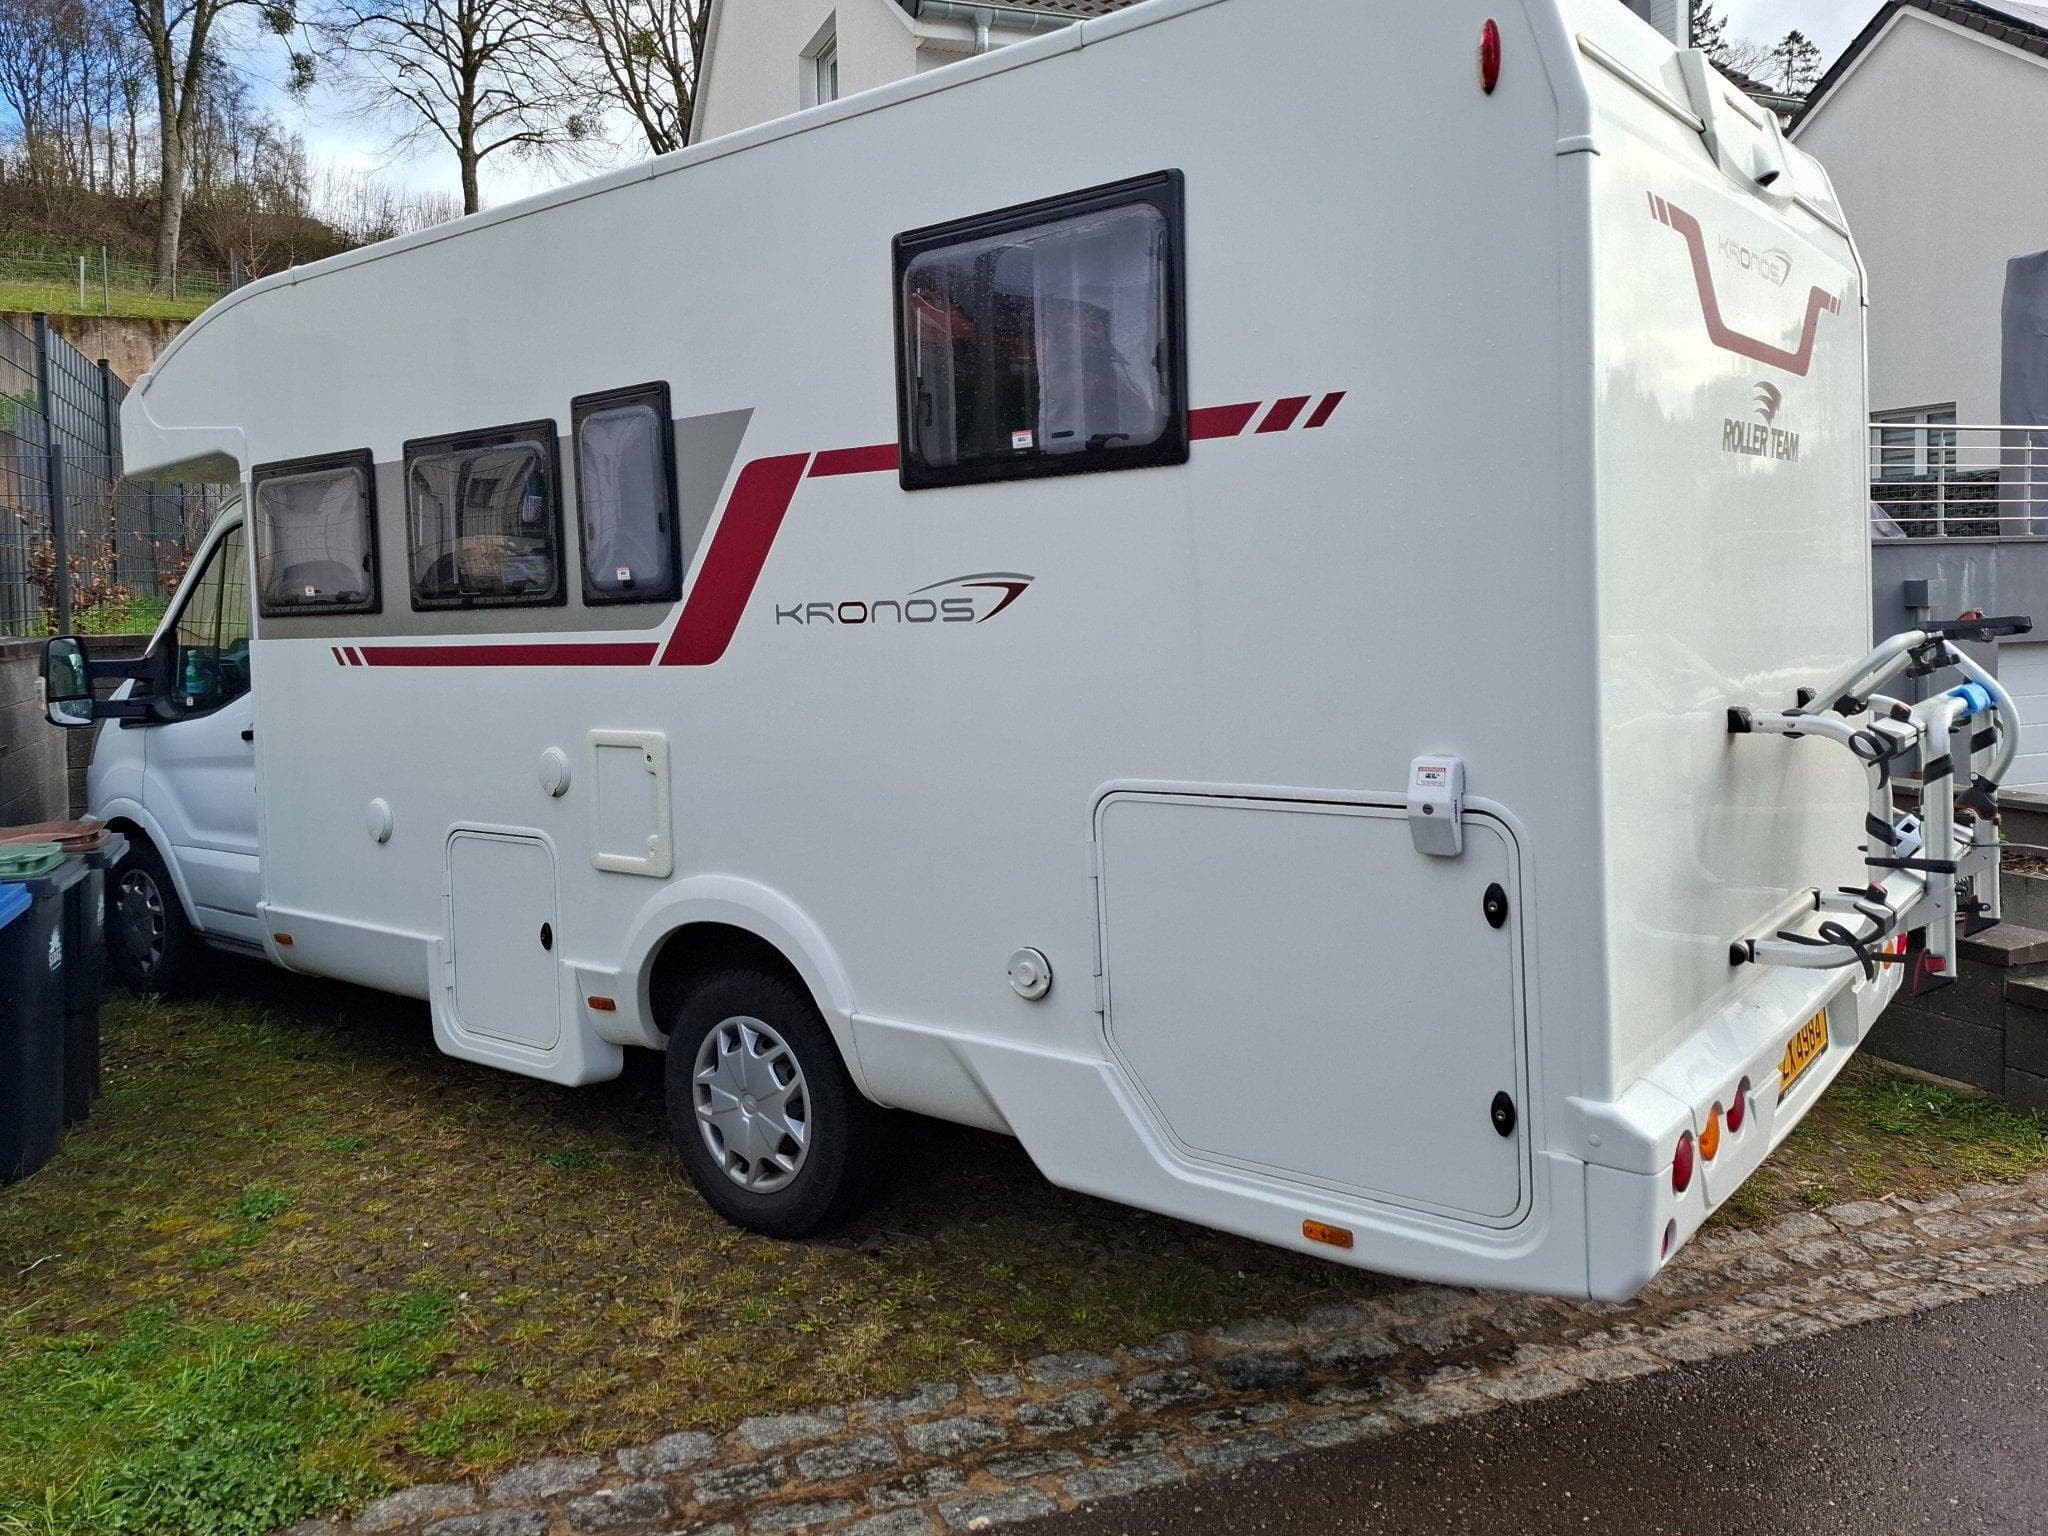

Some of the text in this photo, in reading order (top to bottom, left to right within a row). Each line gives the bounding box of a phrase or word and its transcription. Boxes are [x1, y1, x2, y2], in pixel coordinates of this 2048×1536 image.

[1717, 233, 1781, 286] KRONOS
[1722, 418, 1800, 462] ROLLER TEAM
[776, 597, 975, 626] KRONOS
